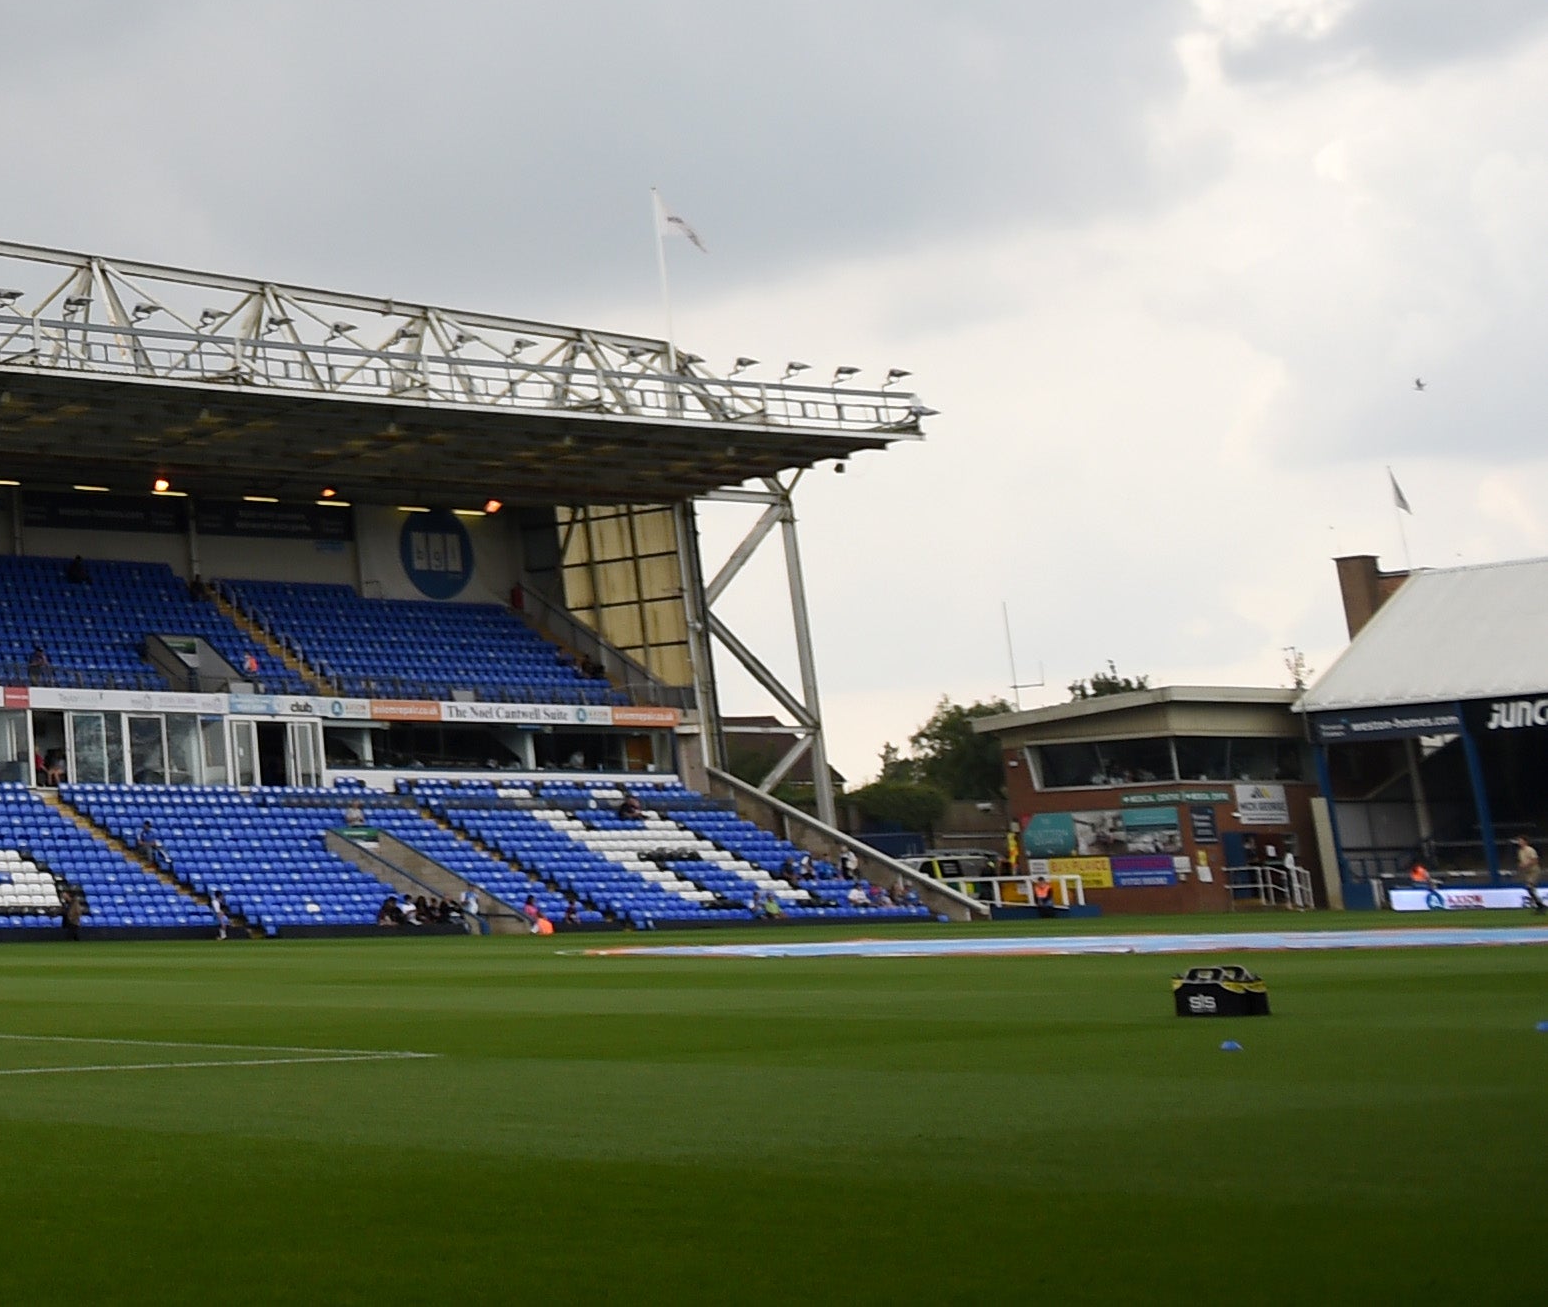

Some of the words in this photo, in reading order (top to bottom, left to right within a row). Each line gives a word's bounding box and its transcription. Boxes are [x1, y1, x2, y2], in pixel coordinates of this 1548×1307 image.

[447, 705, 467, 718] The
[470, 706, 493, 719] Noel
[495, 706, 541, 720] Cantwell
[543, 709, 568, 721] Suite
[1351, 715, 1460, 732] weston-homes.com
